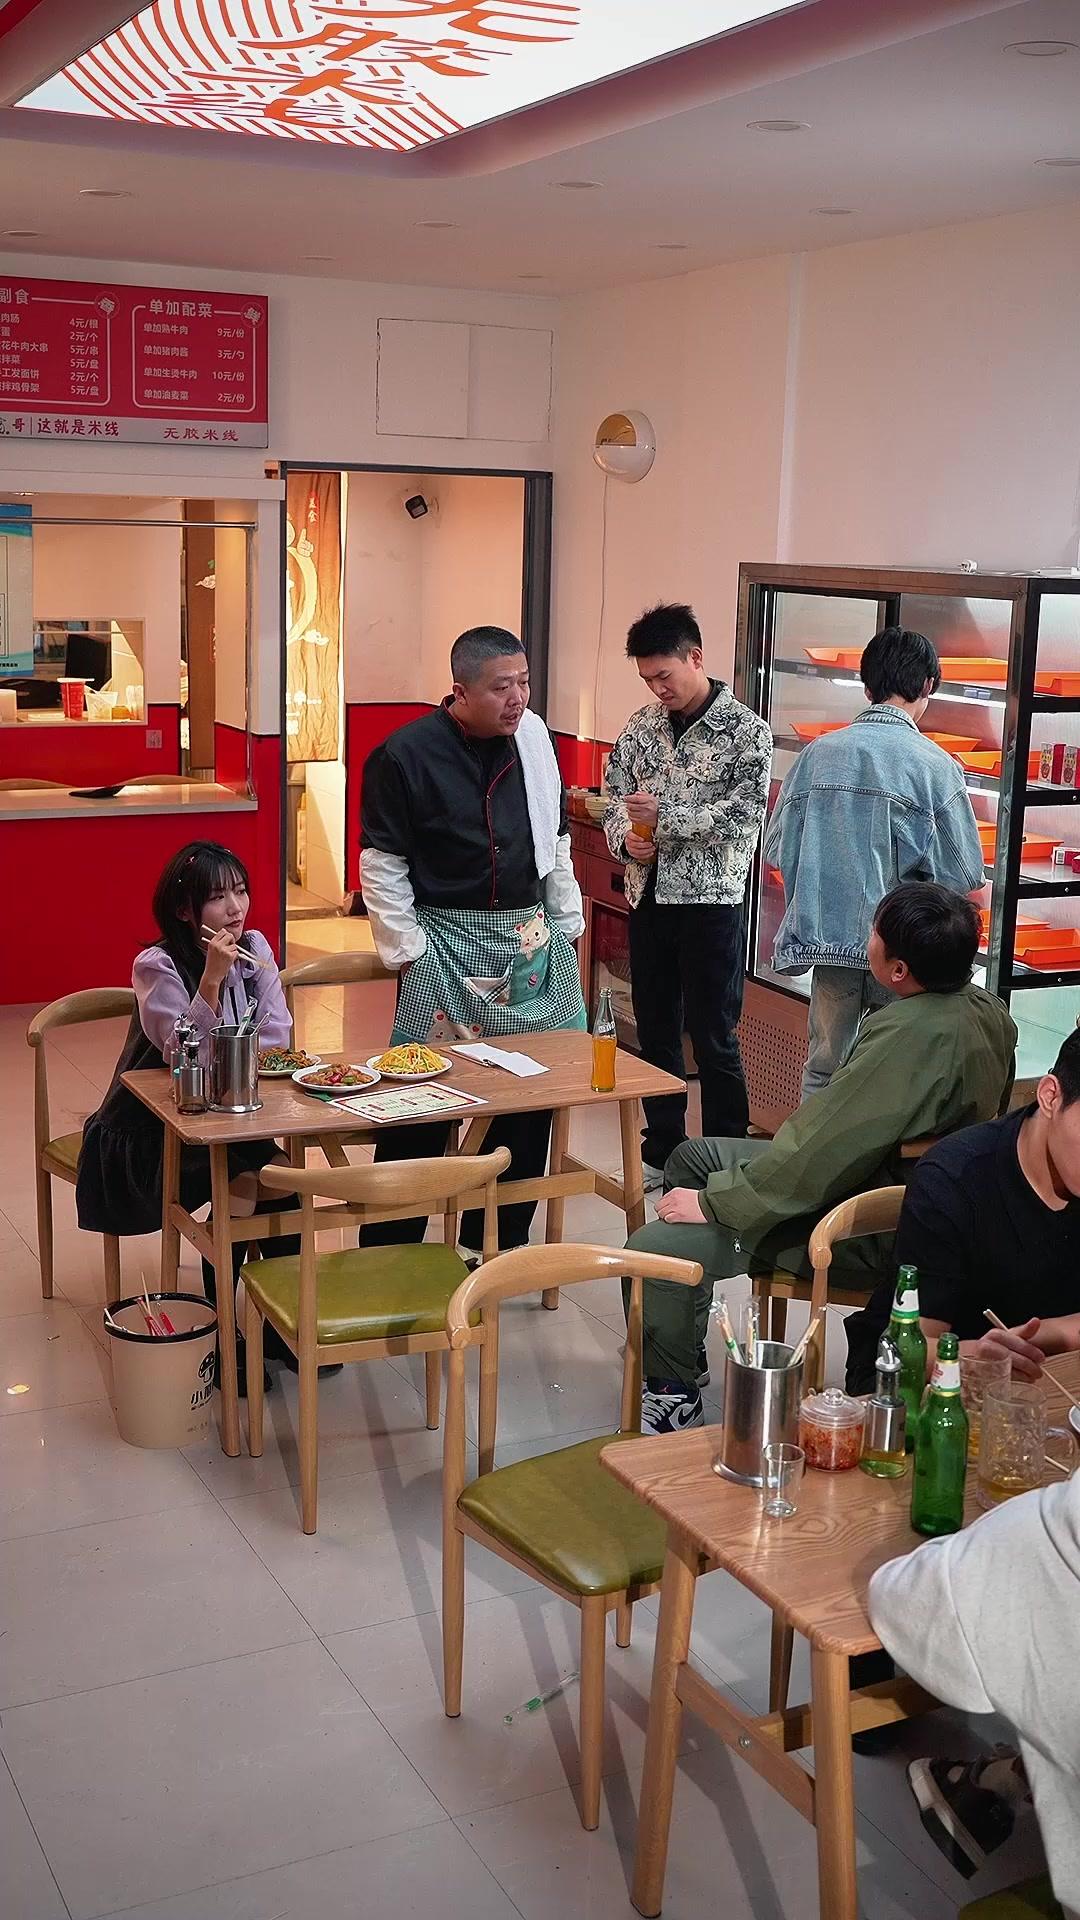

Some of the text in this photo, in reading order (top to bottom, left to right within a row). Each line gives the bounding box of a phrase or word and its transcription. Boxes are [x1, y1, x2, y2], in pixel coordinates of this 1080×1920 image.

[0, 287, 29, 305] 副食
[149, 299, 213, 318] 单加配菜
[69, 318, 99, 329] 4元/根
[143, 322, 189, 335] 单加熟牛肉
[69, 331, 99, 342] 2元/个
[217, 328, 245, 339] 9元/份
[0, 340, 48, 352] 花牛肉大串
[69, 345, 99, 356] 5元/串
[143, 345, 189, 357] 单加猪肉酱
[0, 354, 20, 365] 拌菜
[217, 349, 245, 360] 3元/勺
[69, 359, 99, 369] 5元/盘
[0, 367, 39, 379] 工发面饼
[70, 371, 99, 382] 2元/个
[143, 367, 198, 380] 单加生烫牛肉
[212, 371, 245, 382] 10元/份
[0, 380, 40, 393] 拌鸡骨架
[70, 385, 99, 396] 5元/盘
[143, 389, 189, 401] 单加油麦菜
[217, 393, 245, 404] 2元/份
[37, 418, 119, 437] 这就是米线
[163, 427, 239, 442] 无胶米线
